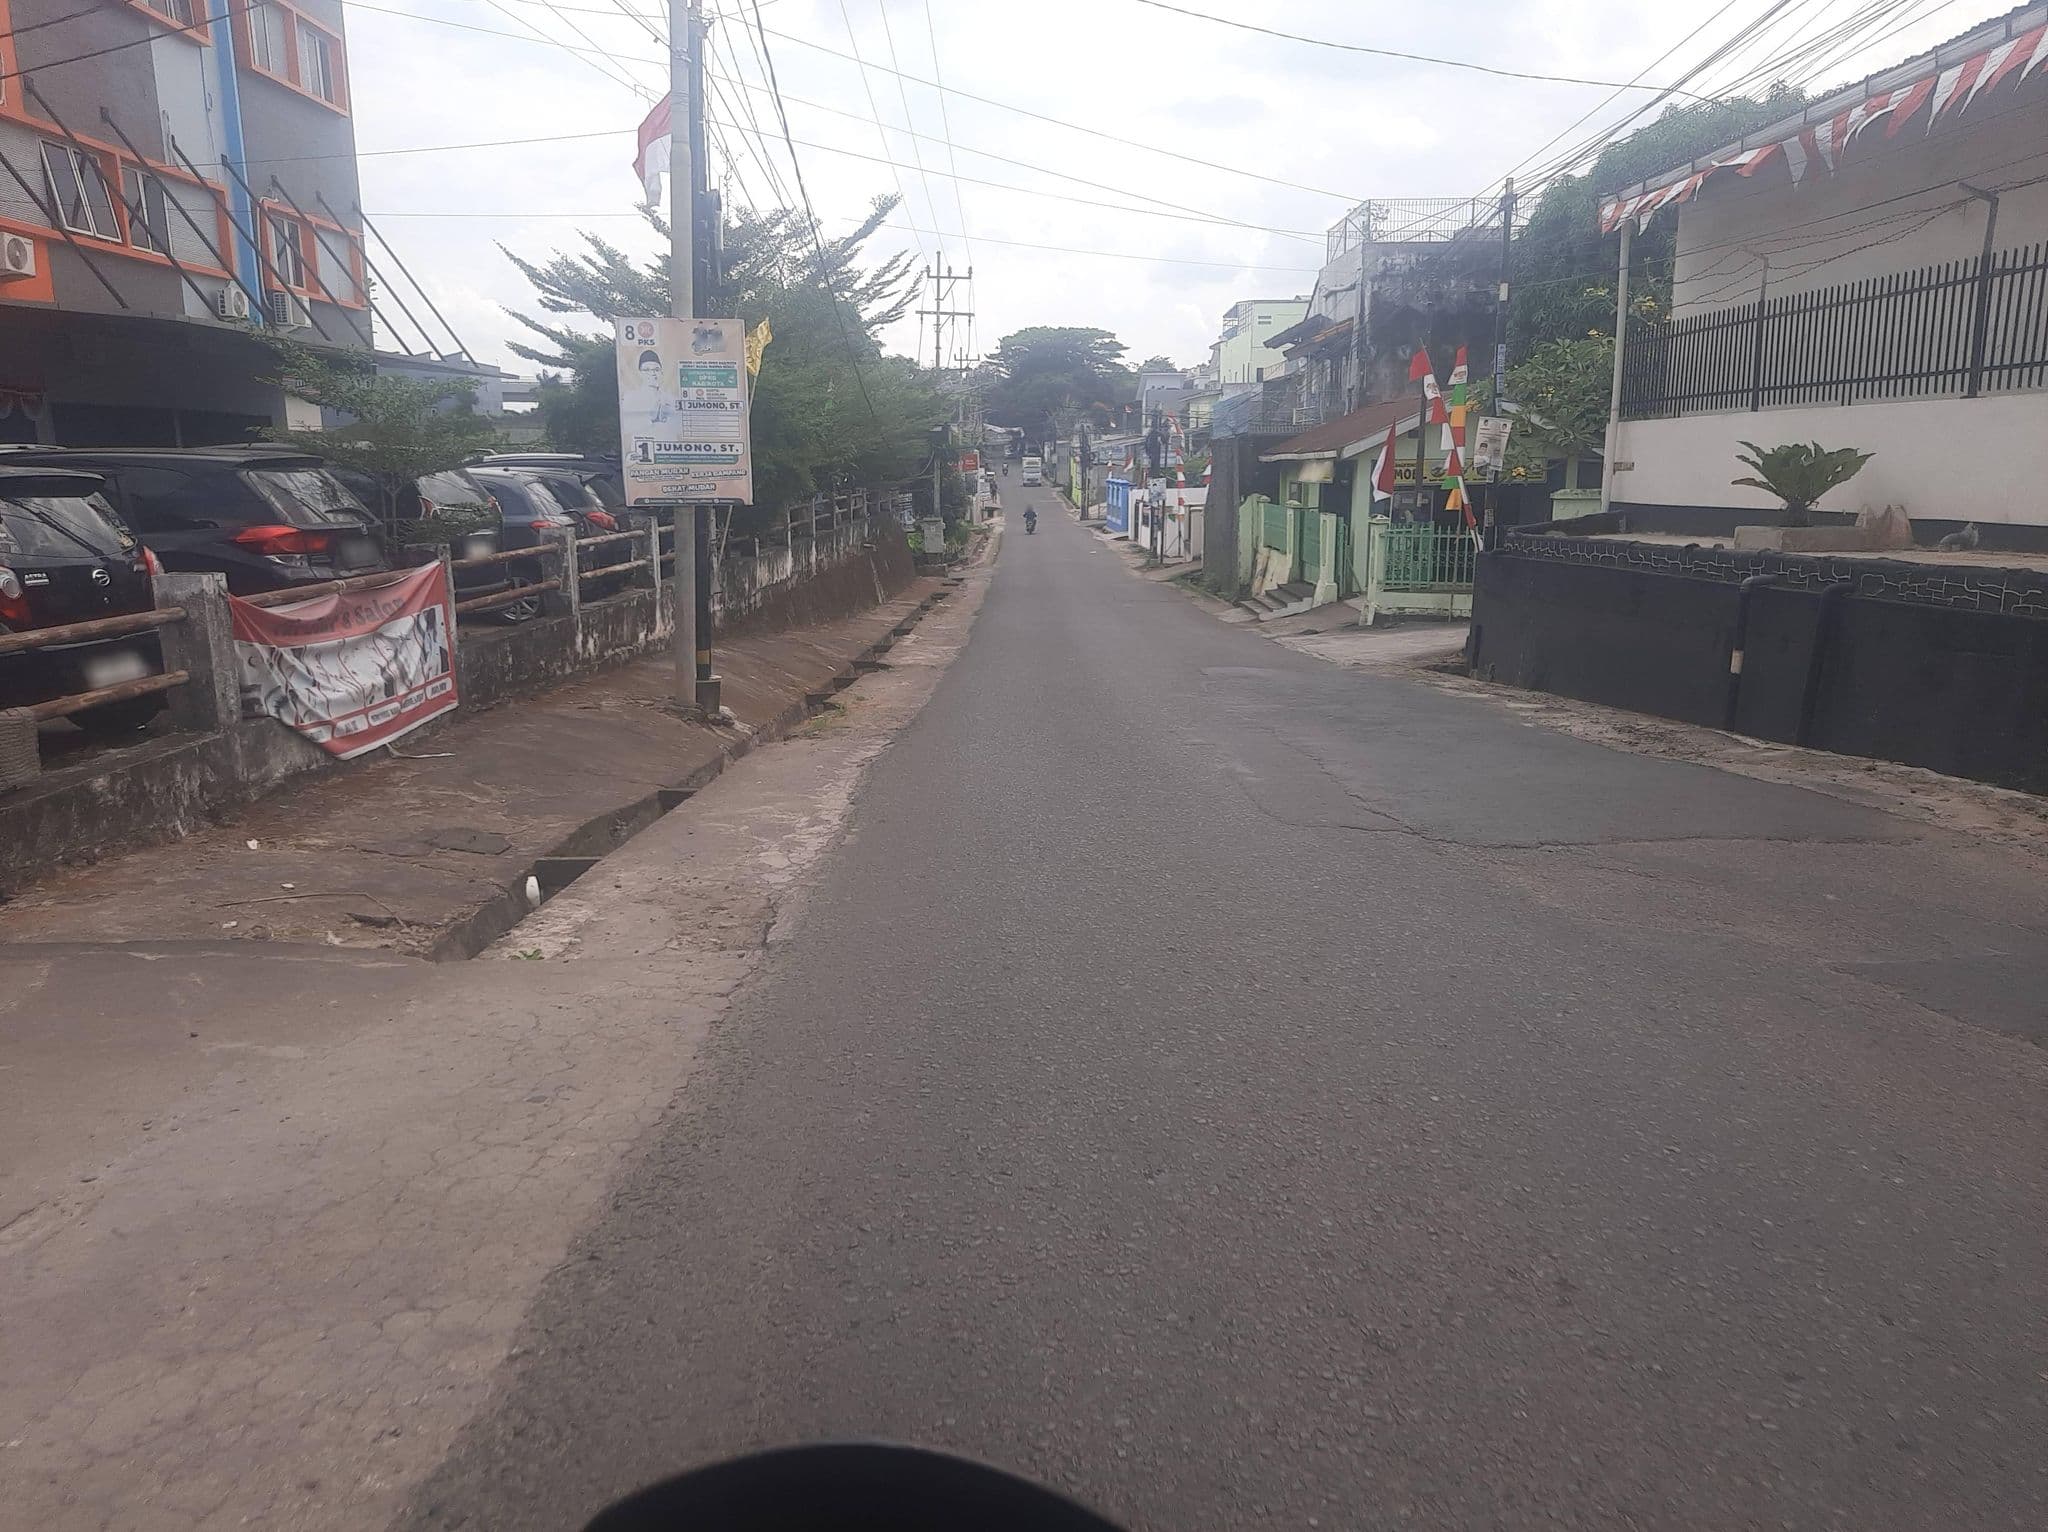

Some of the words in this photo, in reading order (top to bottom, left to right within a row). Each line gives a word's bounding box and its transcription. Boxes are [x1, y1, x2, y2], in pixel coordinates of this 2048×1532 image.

[625, 325, 635, 340] 8
[682, 390, 688, 399] 8
[687, 402, 728, 411] JUMONO,
[638, 442, 653, 463] 1
[655, 443, 717, 453] JUMONO,
[719, 443, 740, 453] ST.
